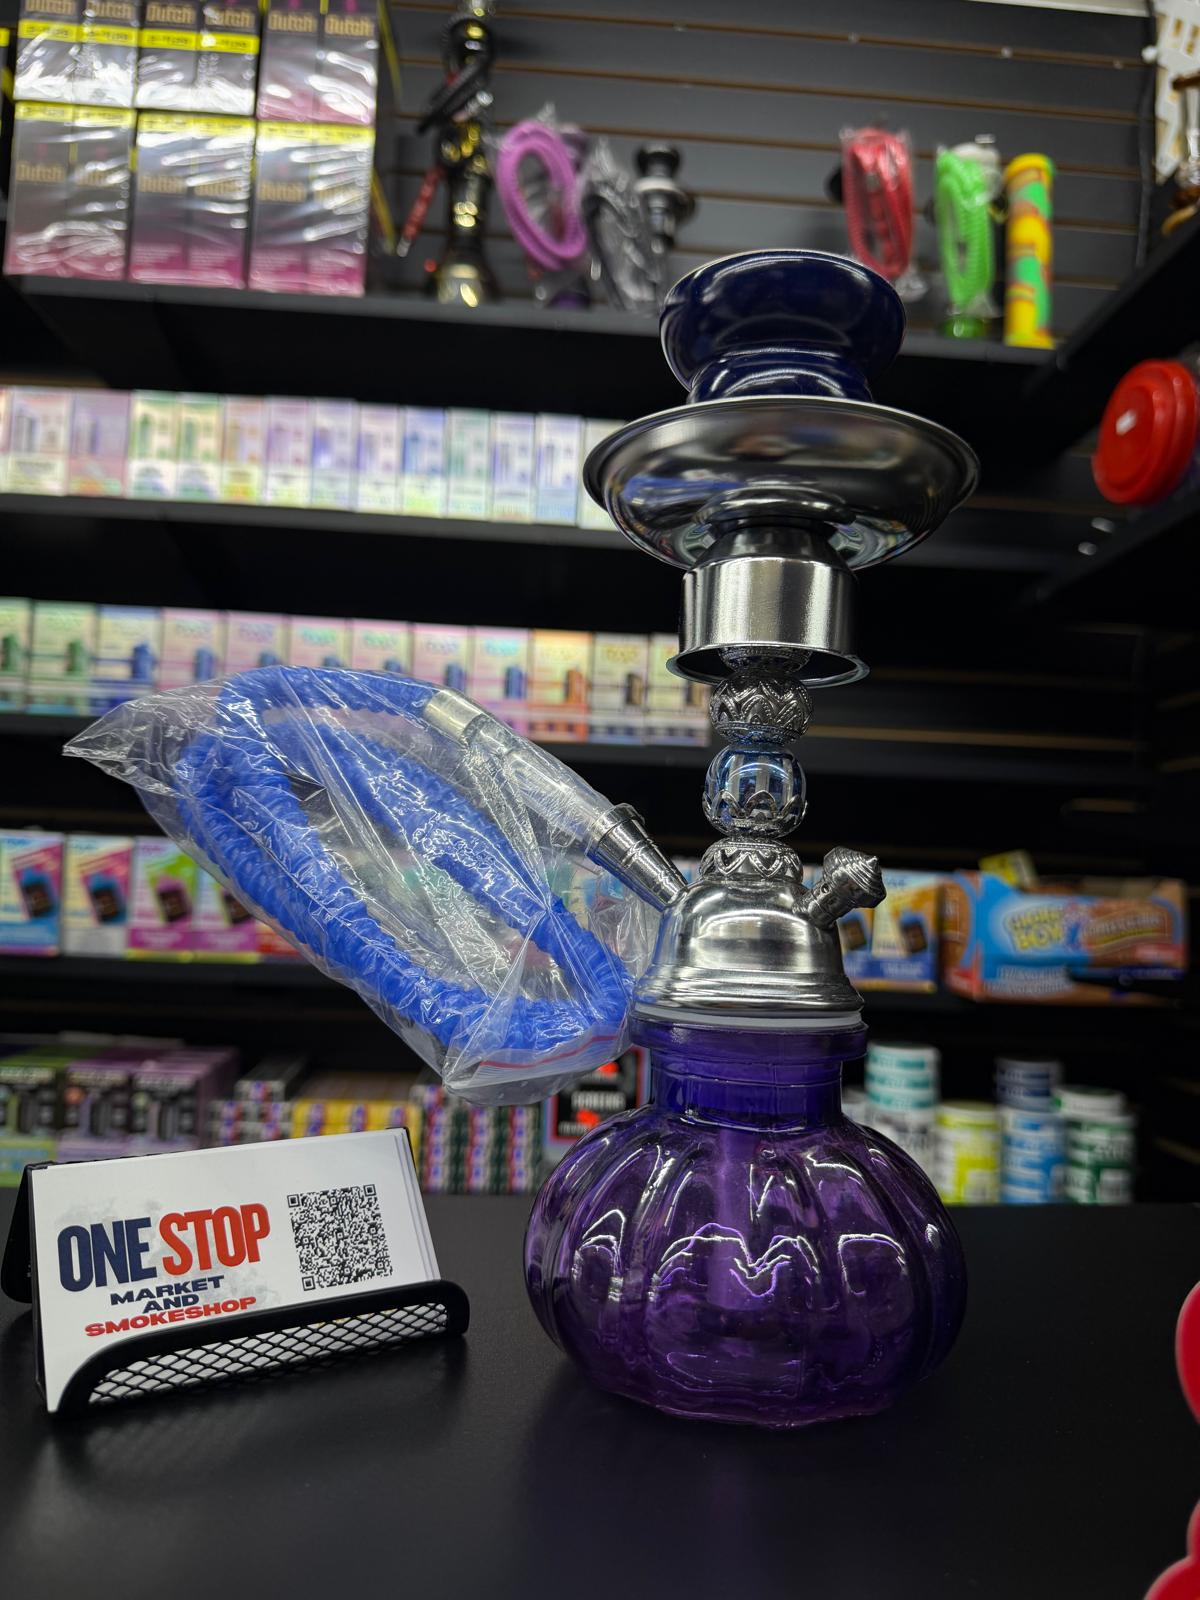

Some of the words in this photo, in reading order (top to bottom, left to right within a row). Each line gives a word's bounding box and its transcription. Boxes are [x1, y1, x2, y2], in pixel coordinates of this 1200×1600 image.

[205, 8, 254, 28] utch
[57, 1217, 157, 1292] ONE
[159, 1203, 270, 1276] STOP
[110, 1275, 224, 1306] MARKET
[143, 1294, 200, 1314] AND
[85, 1296, 257, 1336] SMOKESHOP
